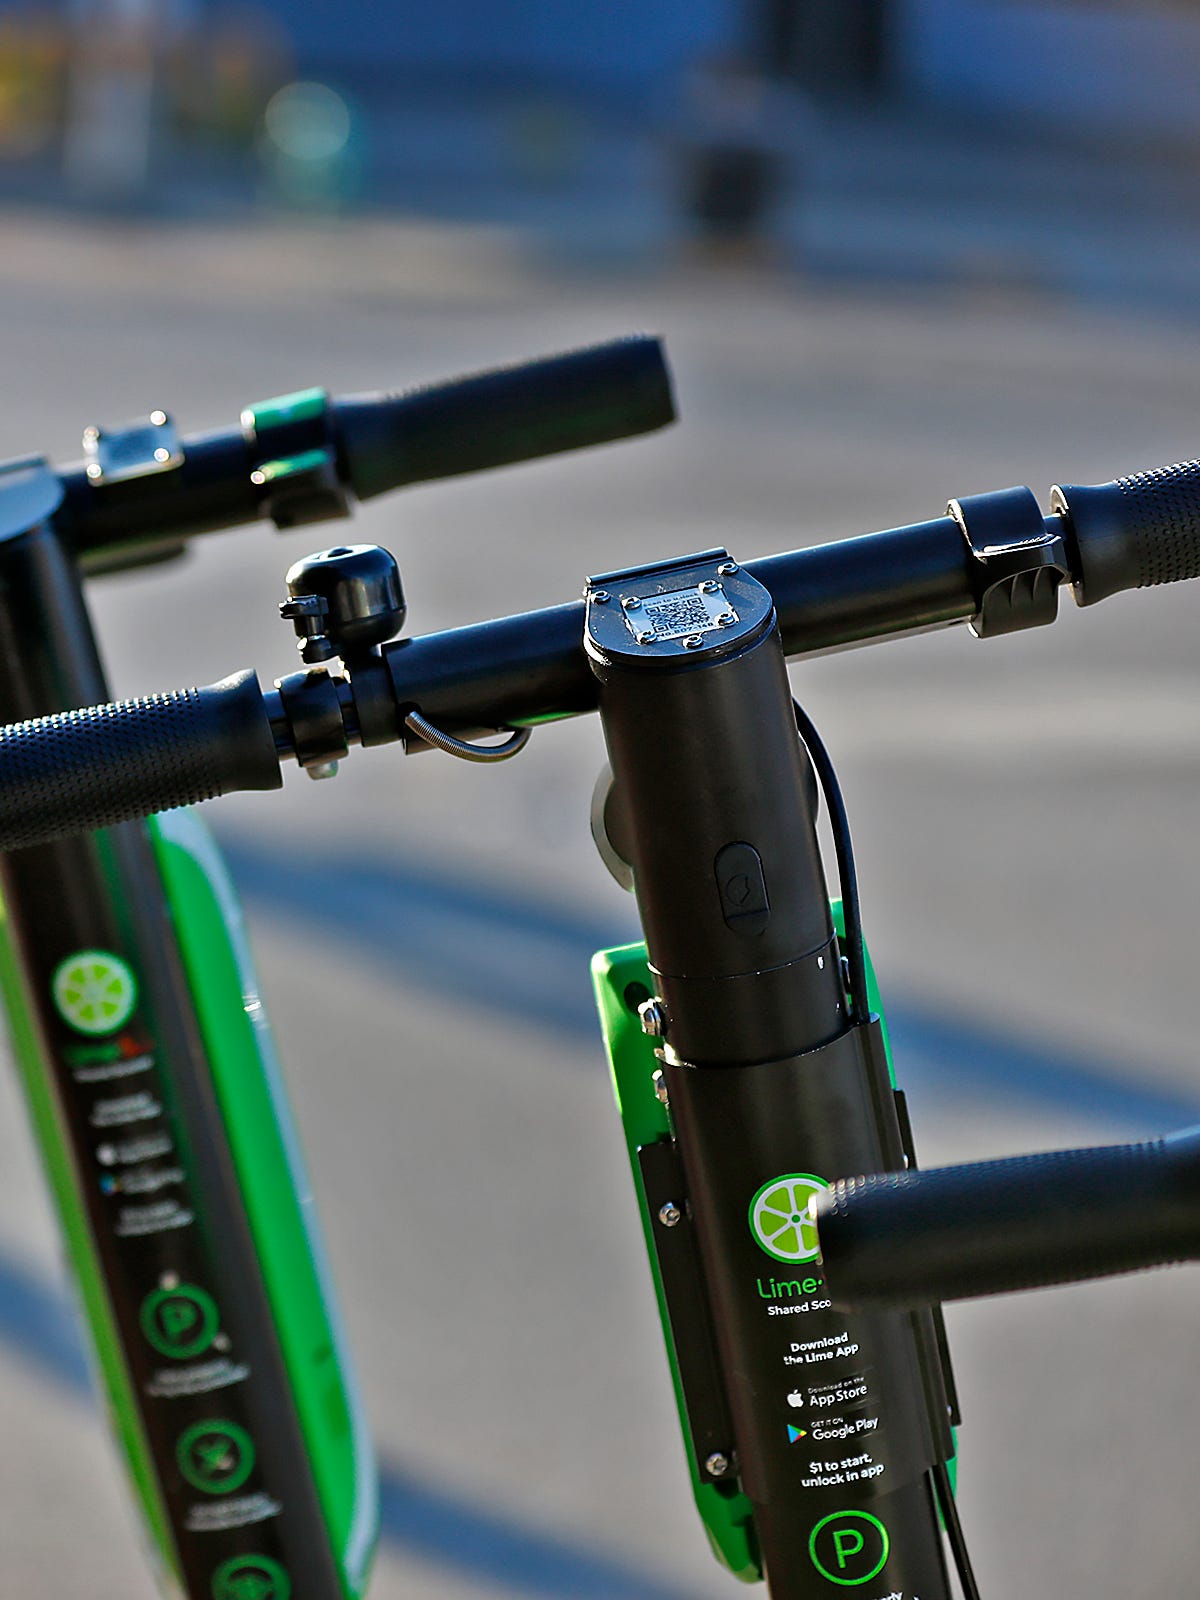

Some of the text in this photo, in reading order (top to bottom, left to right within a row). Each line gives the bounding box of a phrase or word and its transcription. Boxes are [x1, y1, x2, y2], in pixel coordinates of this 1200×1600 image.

[767, 1302, 809, 1316] Shared
[790, 1332, 848, 1352] Download
[783, 1343, 859, 1365] the Lime App
[807, 1382, 842, 1394] Download
[809, 1385, 867, 1407] App Store
[810, 1419, 825, 1428] GET
[832, 1417, 844, 1425] ON
[812, 1417, 879, 1441] Google Play
[809, 1453, 873, 1475] $1 to start,
[801, 1464, 885, 1488] unlock in app
[832, 1528, 864, 1569] P
